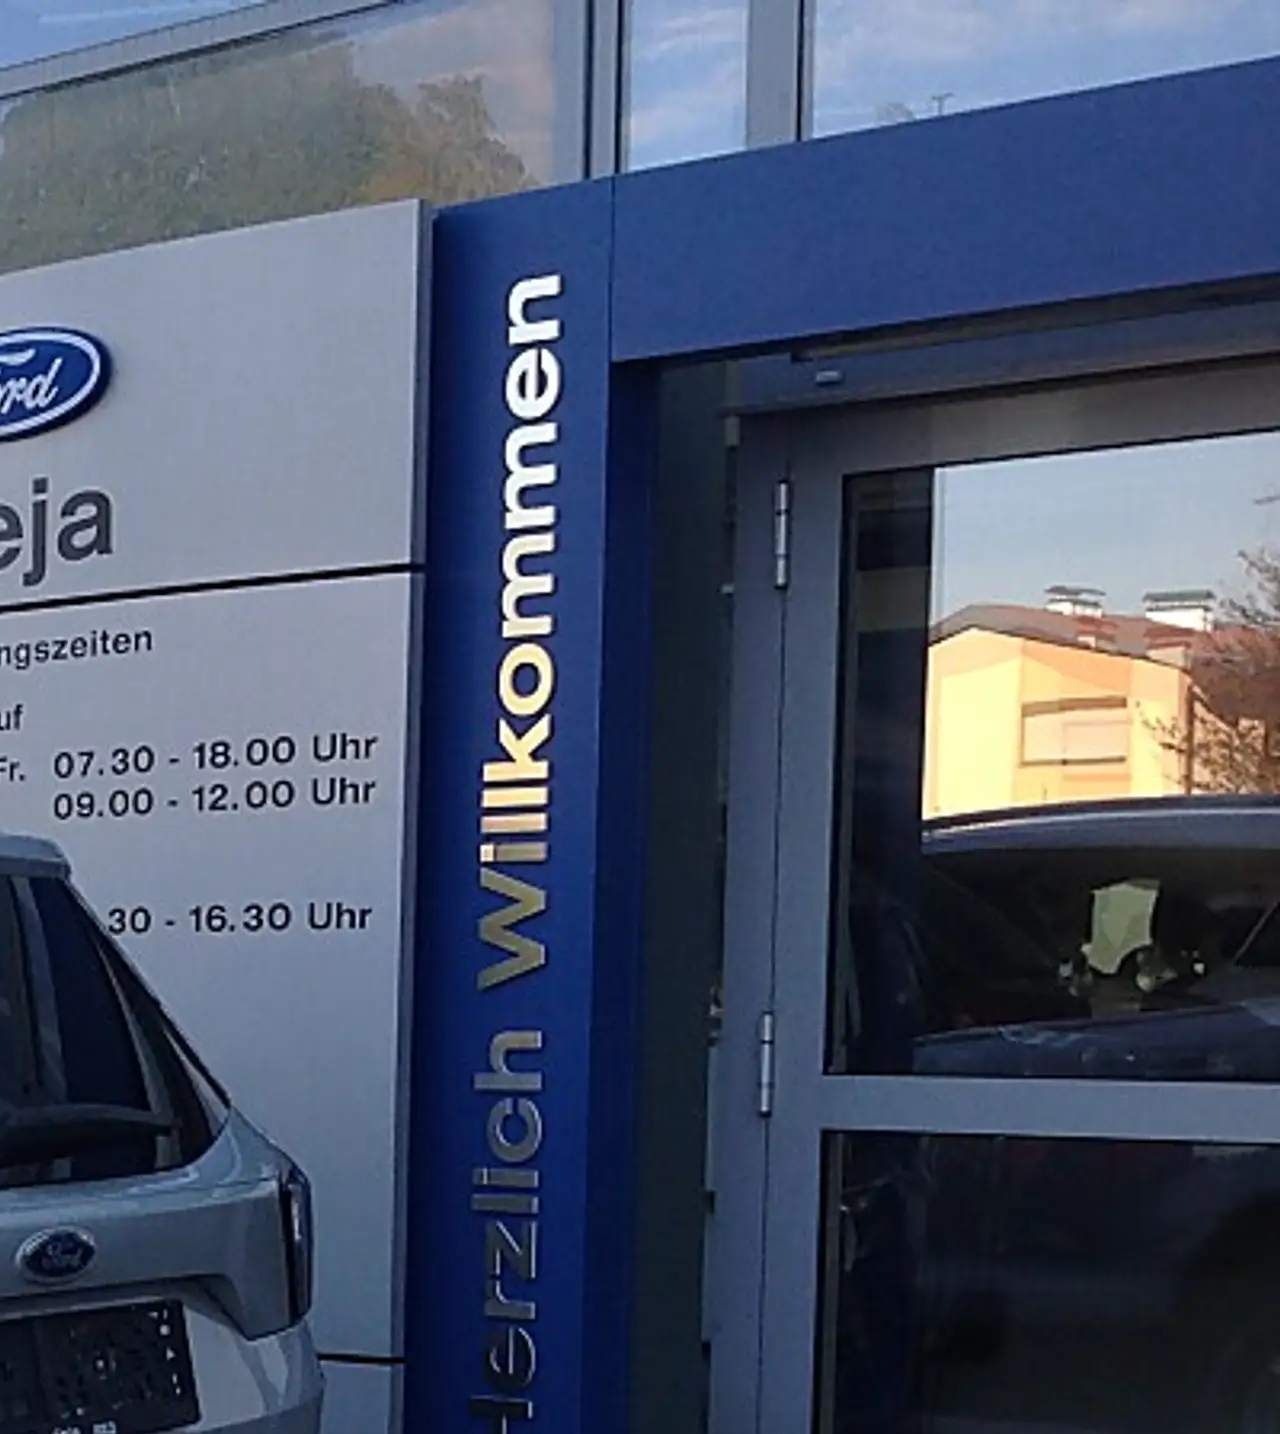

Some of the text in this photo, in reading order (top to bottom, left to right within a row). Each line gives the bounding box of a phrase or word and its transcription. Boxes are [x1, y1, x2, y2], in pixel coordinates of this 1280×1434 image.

[477, 274, 562, 992] Willkommen
[55, 746, 154, 778] 07.30
[194, 736, 295, 769] 18.00
[314, 733, 377, 762] Uhr
[54, 788, 153, 820] 09.00
[192, 780, 294, 811] 12.00
[313, 777, 375, 805] Uhr
[190, 903, 291, 932] 16.30
[309, 903, 372, 929] Uhr
